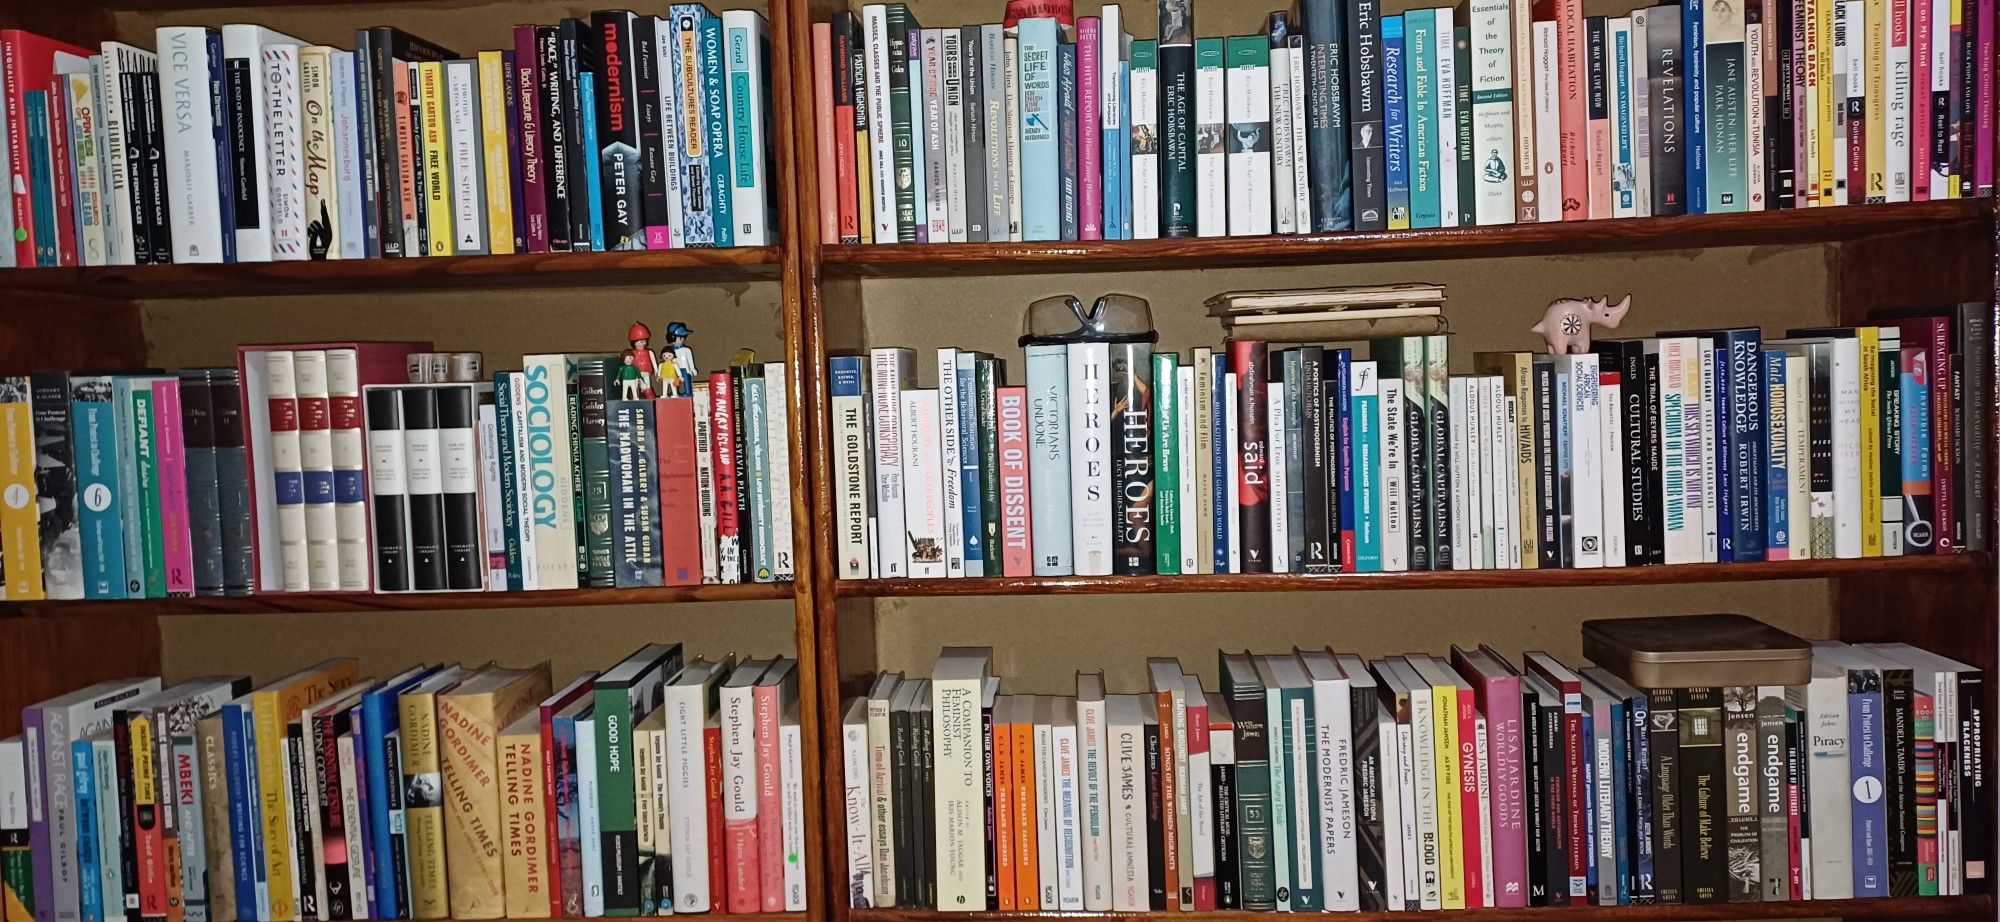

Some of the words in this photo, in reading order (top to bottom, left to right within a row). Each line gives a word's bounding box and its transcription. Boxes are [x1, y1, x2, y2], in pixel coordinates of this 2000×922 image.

[1359, 2, 1372, 29] Eric
[171, 33, 189, 72] VICE
[706, 28, 718, 74] WOMEN
[734, 35, 743, 63] Gerard
[1416, 30, 1427, 53] Form
[311, 66, 319, 88] SIMON
[425, 68, 434, 98] TIMOTHY
[604, 24, 624, 131] modernism
[709, 78, 719, 86] &
[854, 55, 864, 85] PATRICIA
[1085, 66, 1093, 87] HITE
[1360, 34, 1374, 112] Hobsbawm
[1386, 47, 1401, 103] Research
[1417, 57, 1426, 72] and
[1726, 58, 1736, 82] JANE
[735, 76, 747, 121] Country
[1167, 86, 1175, 106] ERIC
[1416, 75, 1428, 98] Fable
[1661, 49, 1675, 153] REVELATIONS
[1715, 85, 1724, 112] PARK
[1891, 61, 1908, 110] killing
[6, 42, 14, 93] INEQUALITY
[11, 119, 20, 170] INSTABILITY
[174, 78, 191, 133] VERSA
[306, 101, 323, 123] On
[427, 101, 435, 128] GARTON
[710, 90, 720, 120] SOAP
[855, 88, 867, 126] HIGHSMITH
[1085, 90, 1093, 125] REPORT
[1178, 117, 1185, 130] OF
[1390, 109, 1400, 120] for
[312, 130, 324, 149] the
[341, 113, 351, 181] Johannesburg
[429, 130, 437, 143] ASH
[553, 120, 562, 141] AND
[711, 122, 723, 158] OPERA
[738, 125, 749, 160] House
[1168, 109, 1176, 160] HOBSBAWM
[1388, 124, 1403, 171] Writers
[1417, 115, 1429, 158] American
[1715, 114, 1724, 153] HONAN
[1728, 133, 1737, 155] HER
[1891, 116, 1906, 148] rage
[305, 141, 326, 196] Map
[430, 150, 439, 168] FREE
[1178, 133, 1186, 172] CAPITAL
[1729, 158, 1738, 178] LIFE
[431, 172, 440, 200] WORLD
[554, 145, 565, 199] DIFFERENCE
[614, 154, 624, 195] PETER
[740, 163, 750, 183] Life
[1418, 161, 1430, 192] Fiction
[153, 179, 161, 205] FEMALE
[717, 174, 726, 214] GERAGHTY
[617, 200, 627, 225] GAY
[1936, 323, 1947, 376] SURFACING
[716, 381, 728, 395] THE
[943, 360, 952, 383] THE
[1734, 340, 1747, 433] KNOWLEDGE
[1746, 341, 1759, 431] DANGEROUS
[1769, 357, 1782, 383] Male
[1937, 378, 1947, 389] UP
[944, 386, 953, 425] OTHER
[1199, 372, 1207, 411] Feminism
[1386, 388, 1398, 404] The
[137, 399, 149, 457] DEFIANT
[618, 409, 630, 428] THE
[715, 399, 728, 430] ANGRY
[845, 408, 857, 429] THE
[1002, 396, 1021, 443] BOOK
[1387, 407, 1398, 430] State
[1629, 394, 1641, 464] CULTURAL
[1769, 384, 1786, 469] HOMOSEXUALITY
[524, 365, 557, 529] SOCIOLOGY
[717, 433, 730, 465] ISLAND
[945, 429, 955, 454] SIDE
[1200, 432, 1208, 450] Film
[1387, 433, 1399, 458] We're
[1435, 411, 1447, 460] GLOBAL
[1519, 424, 1532, 463] HIV/AIDS
[620, 432, 633, 493] MADWOMAN
[846, 435, 859, 500] GOLDSTONE
[1005, 449, 1023, 472] OF
[1123, 409, 1149, 543] HEROES
[1244, 441, 1263, 485] said
[1388, 461, 1398, 469] In
[1739, 443, 1749, 490] ROBERT
[623, 498, 634, 509] IN
[947, 469, 957, 509] Freedom
[1389, 481, 1398, 497] Will
[1436, 464, 1448, 537] CAPITALISM
[1631, 467, 1643, 521] STUDIES
[624, 514, 635, 532] THE
[721, 499, 734, 532] GILL
[850, 503, 862, 545] REPORT
[1005, 476, 1026, 549] DISSENT
[1390, 501, 1399, 529] Hutton
[1740, 495, 1750, 531] IRWIN
[625, 536, 637, 563] ATTIC
[962, 688, 971, 696] A
[608, 715, 617, 743] GOOD
[729, 697, 741, 745] Stephen
[941, 689, 952, 758] PHILOSOPHY
[952, 689, 961, 739] FEMINIST
[49, 713, 65, 768] AGAINST
[962, 700, 972, 768] COMPANION
[1120, 733, 1134, 763] CLIVE
[1321, 725, 1329, 745] THE
[1495, 722, 1506, 782] WORLDLY
[1507, 719, 1518, 753] LISA
[1813, 736, 1846, 747] Piracy
[1963, 721, 1971, 777] BLACKNESS
[1972, 709, 1982, 787] APPROPRIATING
[206, 736, 217, 790] CLASSICS
[506, 744, 519, 806] TELLING
[521, 744, 533, 804] NADINE
[609, 746, 619, 772] HOPE
[729, 750, 743, 769] Jay
[1338, 739, 1349, 785] FREDRIC
[1462, 742, 1475, 792] GYNESIS
[1597, 738, 1609, 778] MODERN
[1733, 732, 1752, 813] endgame
[1764, 734, 1782, 813] endgame
[53, 774, 67, 809] RACE
[178, 754, 194, 805] MBEKI
[733, 775, 744, 812] Gould
[964, 772, 972, 786] TO
[1121, 766, 1134, 800] JAMES
[1321, 749, 1332, 813] MODERNIST
[1508, 758, 1521, 830] JARDINE
[1340, 789, 1351, 839] JAMESON
[1498, 784, 1508, 827] GOODS
[1599, 780, 1610, 823] LITERARY
[509, 813, 521, 856] TIMES
[524, 811, 538, 894] GORDIMER
[1325, 817, 1335, 855] PAPERS
[1600, 824, 1612, 859] THEORY
[1663, 829, 1673, 849] Words
